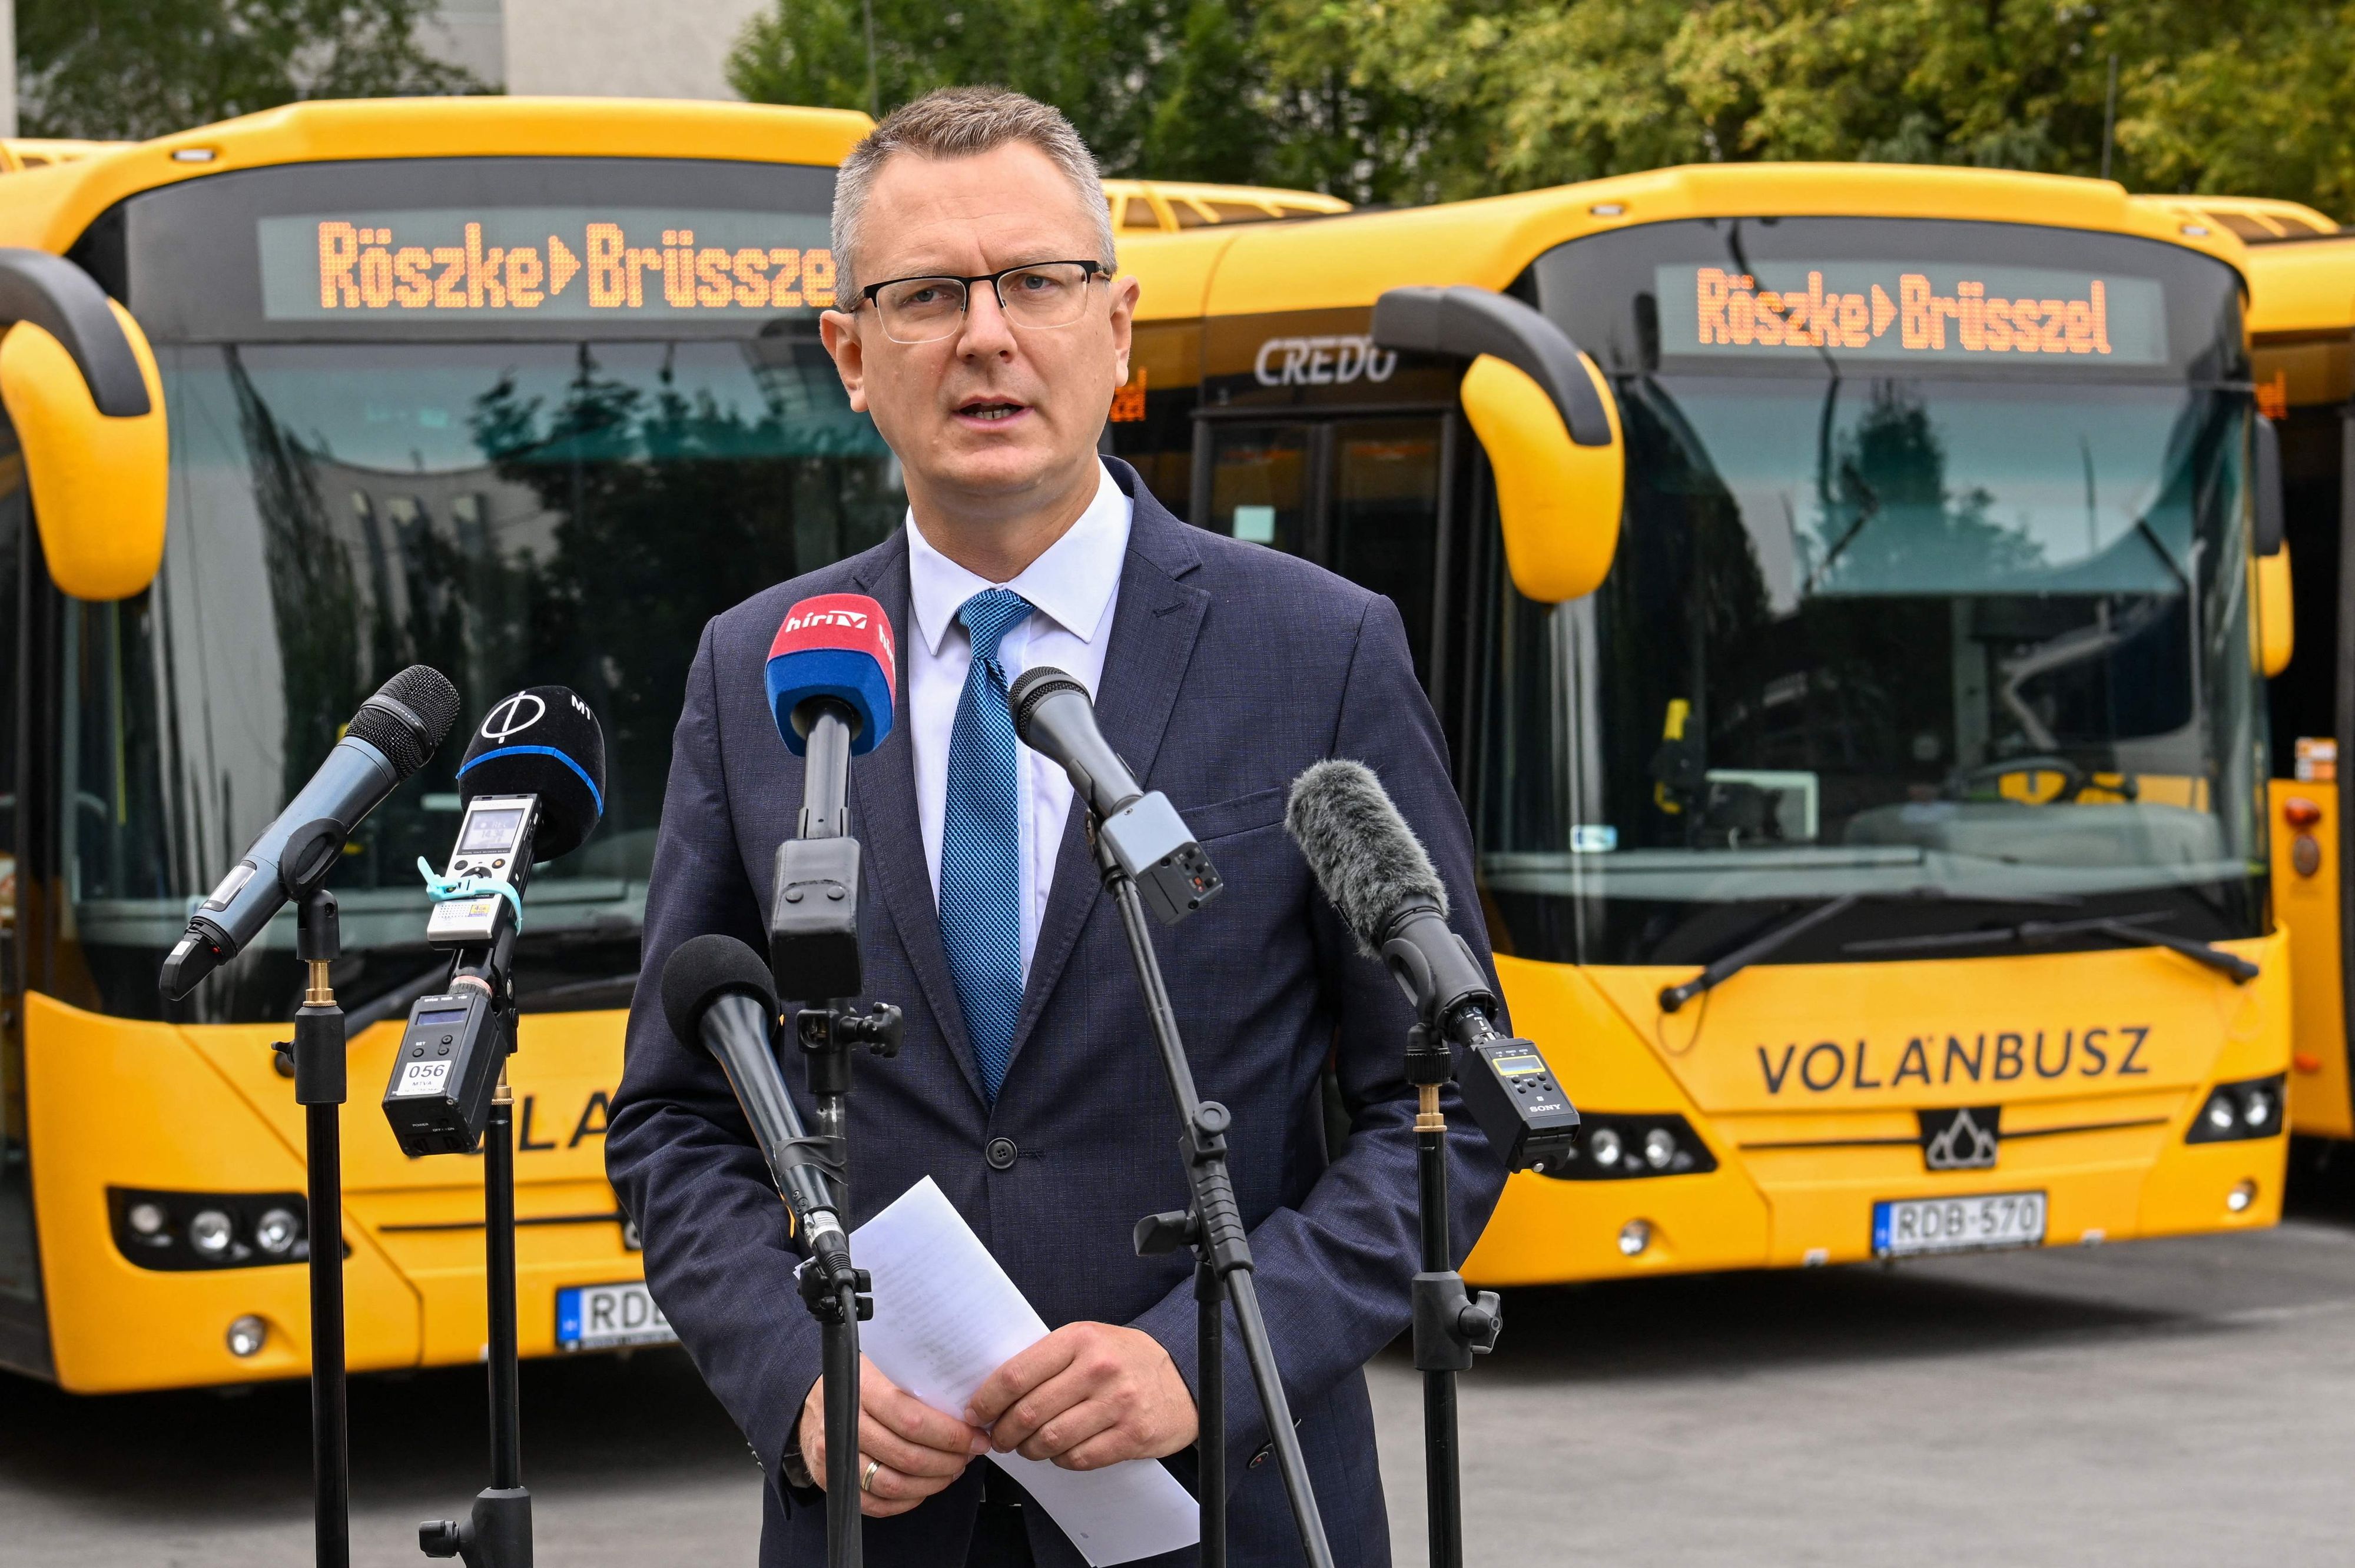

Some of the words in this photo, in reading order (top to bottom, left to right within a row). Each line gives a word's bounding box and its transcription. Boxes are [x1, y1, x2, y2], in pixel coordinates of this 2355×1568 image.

[319, 222, 544, 308] Röszke
[1697, 268, 1870, 348] Röszke
[1900, 274, 2112, 354] Brüsszel
[1254, 335, 1397, 386] CREDO
[571, 695, 591, 720] M1
[409, 1064, 445, 1078] 056
[1757, 1026, 2151, 1094] VOLÁNBUSZ
[1530, 1104, 1561, 1112] SONY
[1898, 1195, 2039, 1240] RDB-570
